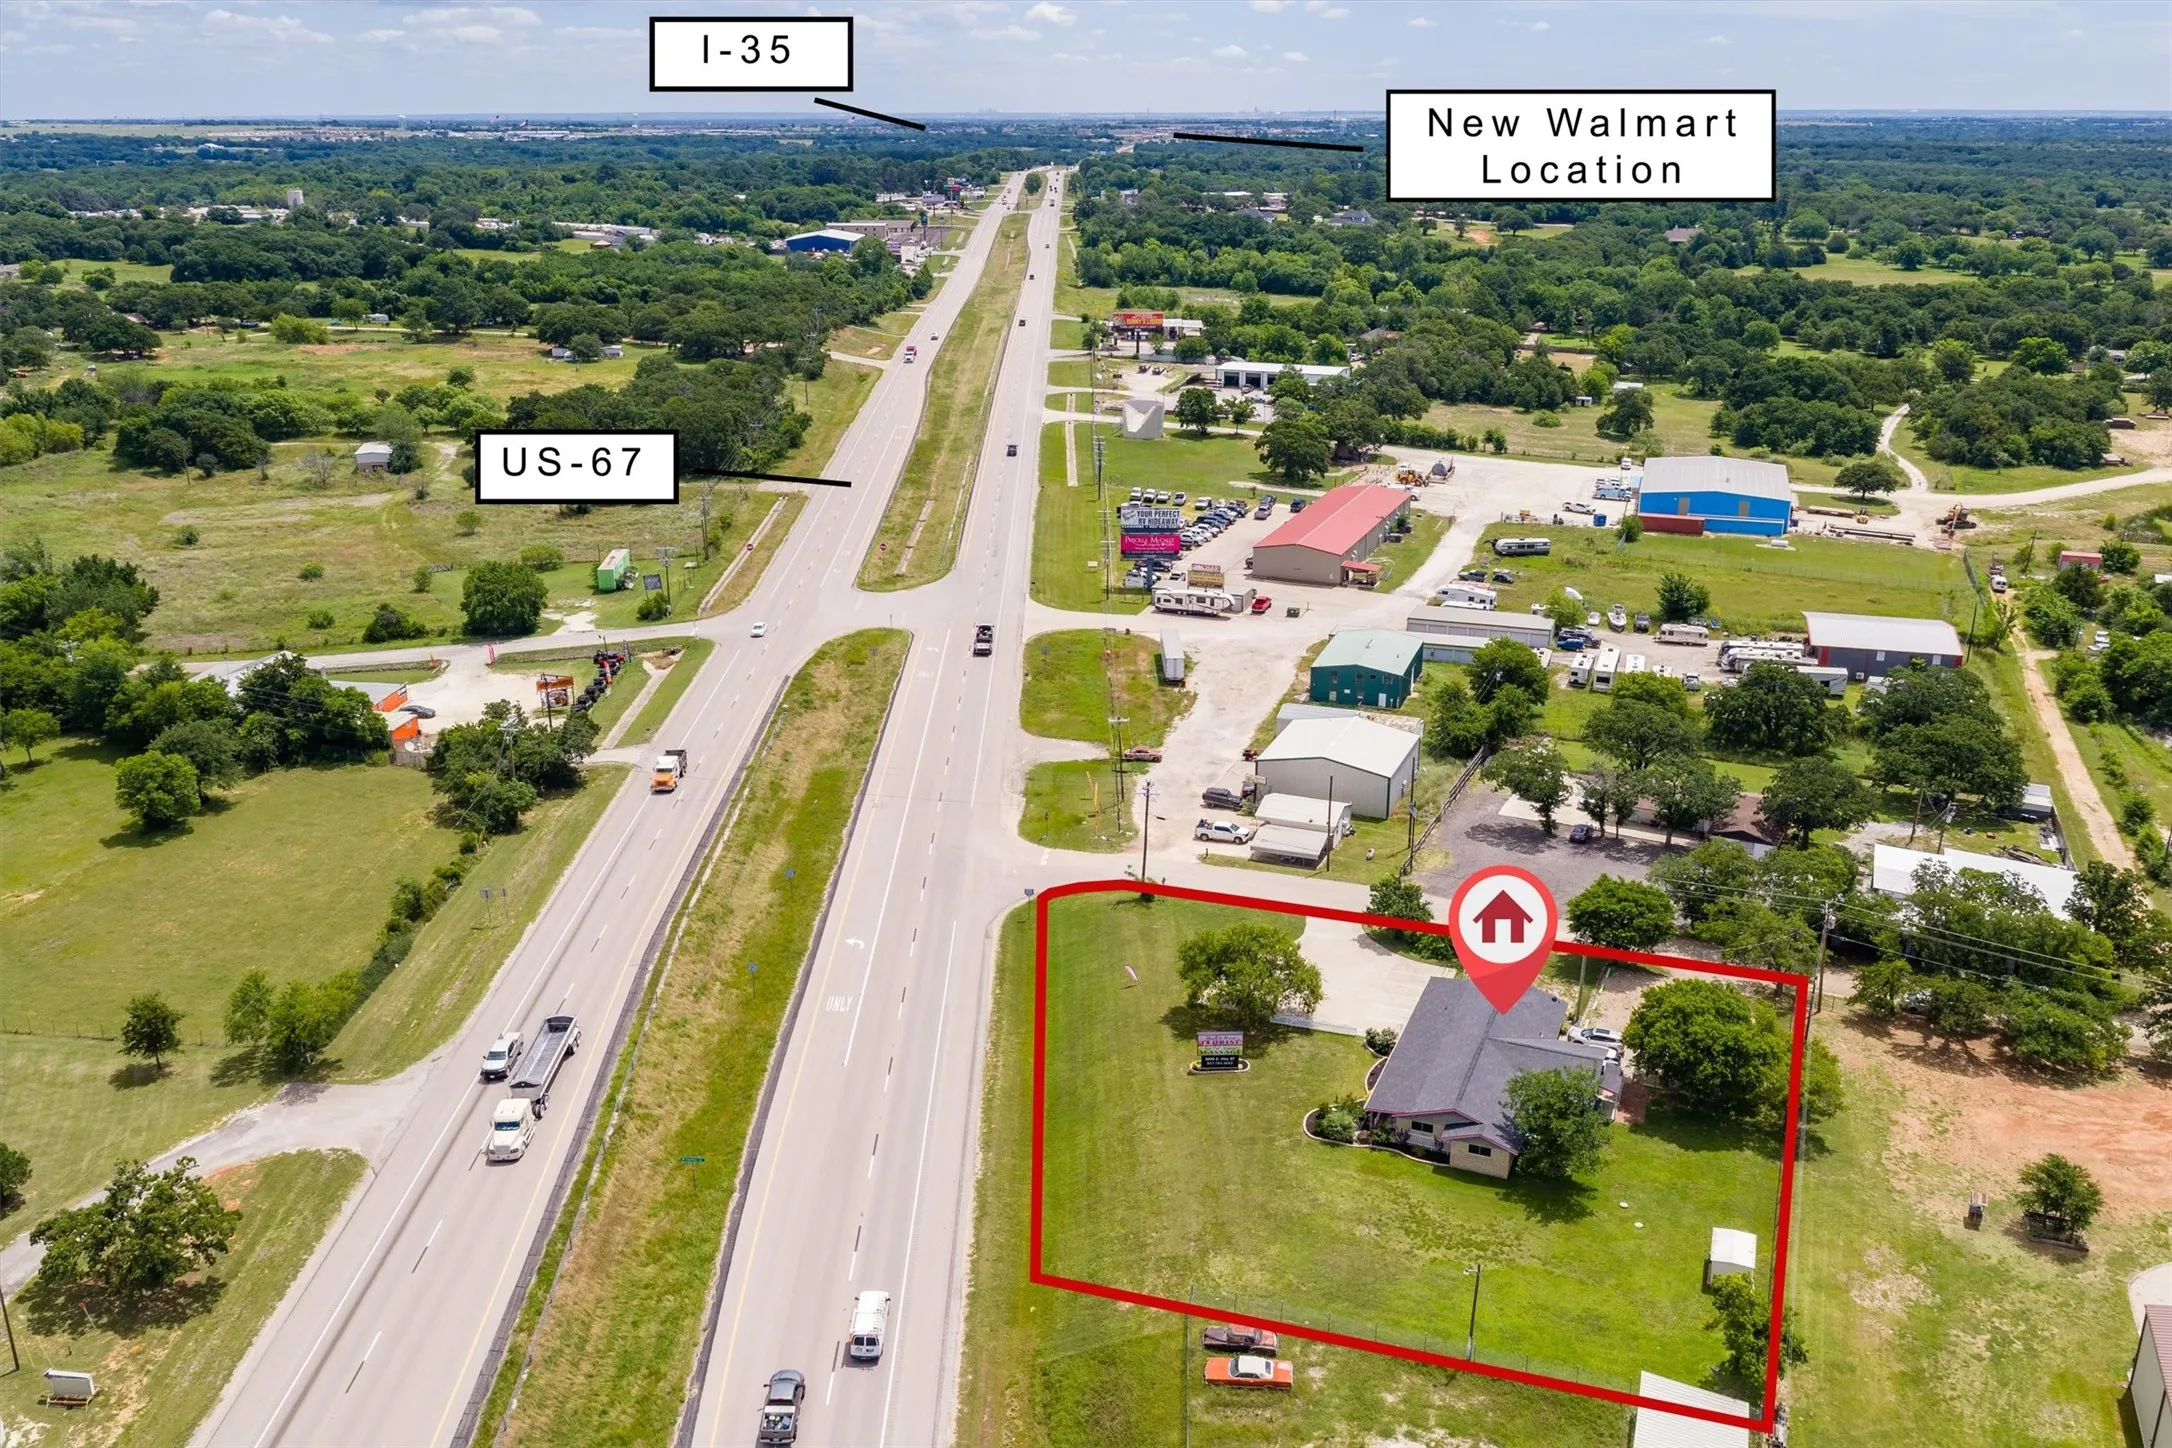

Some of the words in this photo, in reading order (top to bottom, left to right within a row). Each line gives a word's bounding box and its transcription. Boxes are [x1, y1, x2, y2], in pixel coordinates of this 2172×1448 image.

[1137, 510, 1153, 518] YOUR
[1154, 510, 1180, 518] PERFECT
[826, 996, 853, 1011] ONLY
